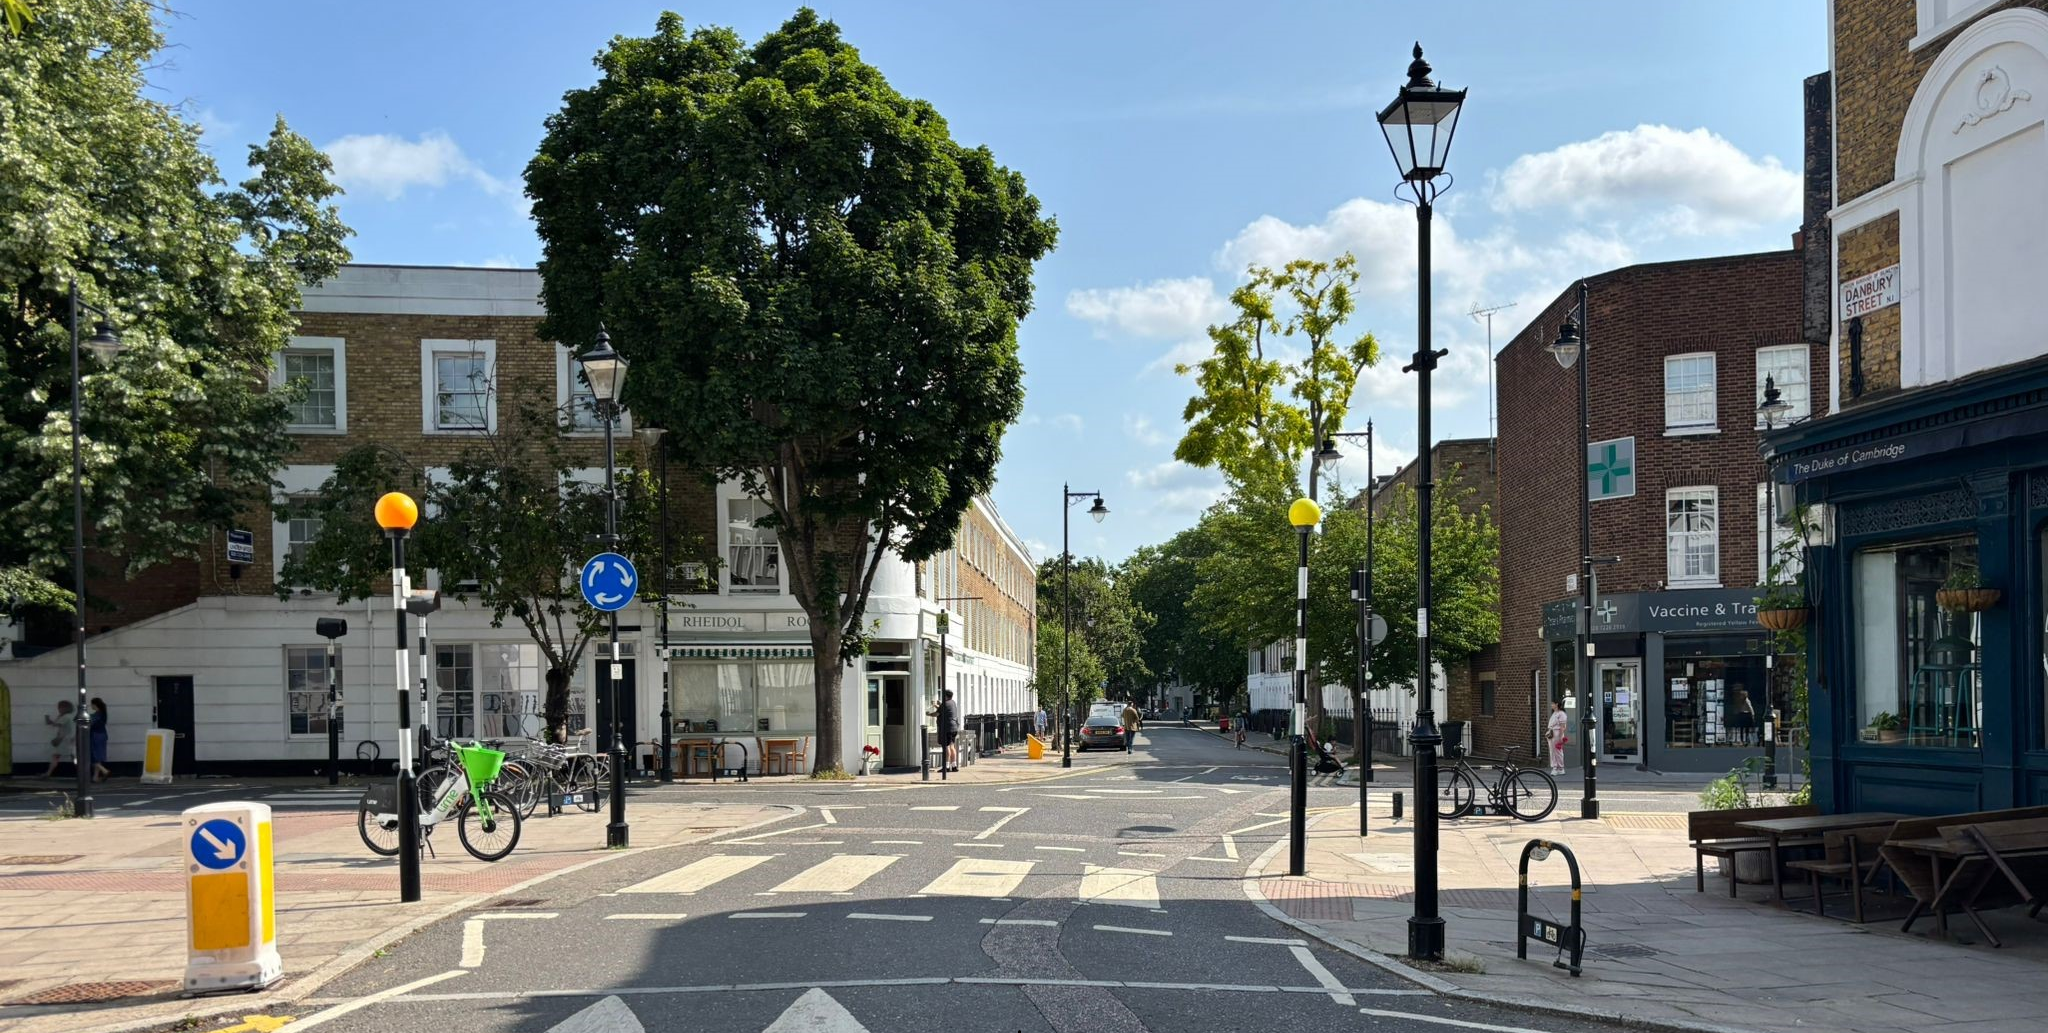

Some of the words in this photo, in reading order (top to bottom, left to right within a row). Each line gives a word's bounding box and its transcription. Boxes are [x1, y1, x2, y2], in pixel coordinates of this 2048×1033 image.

[1846, 274, 1893, 302] DANBURY
[1846, 293, 1882, 317] STREET
[1793, 463, 1810, 475] The
[1812, 458, 1834, 472] Duke
[1836, 452, 1849, 466] of
[1852, 444, 1906, 463] Cambridge
[1648, 604, 1709, 618] Vaccine
[1714, 603, 1726, 615] &
[1732, 602, 1760, 614] Tra
[683, 616, 745, 628] RHEIDOL
[436, 789, 458, 812] Lime
